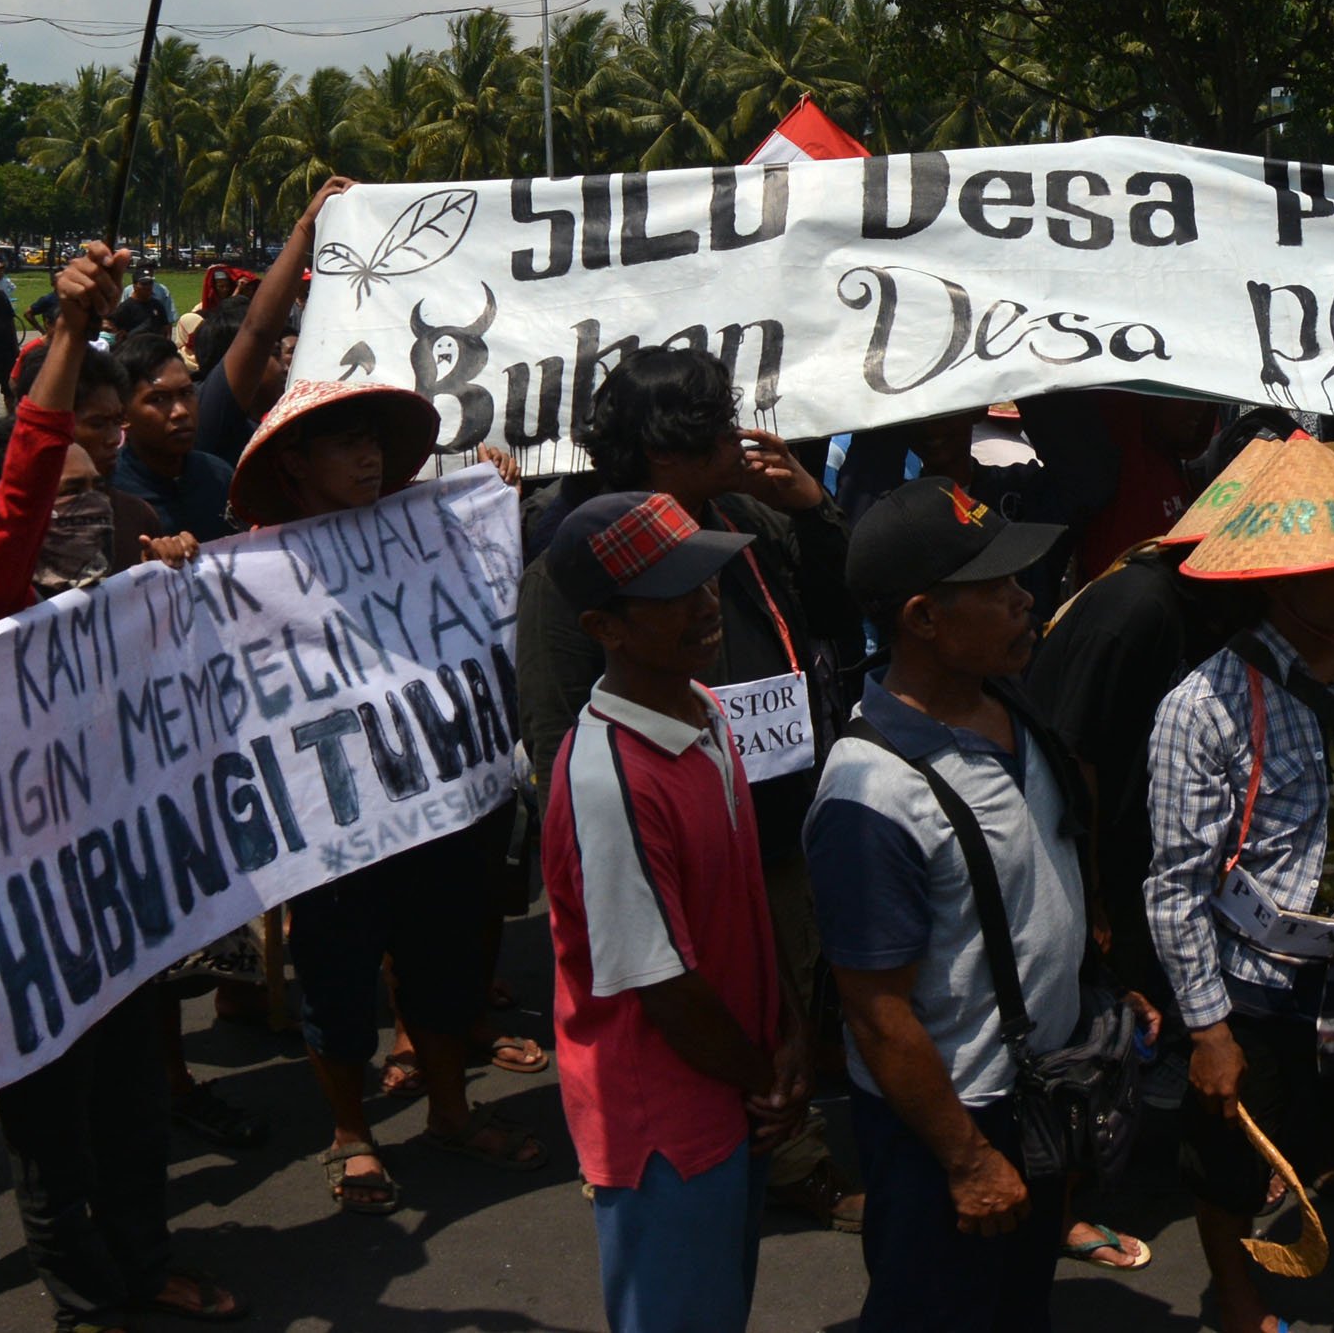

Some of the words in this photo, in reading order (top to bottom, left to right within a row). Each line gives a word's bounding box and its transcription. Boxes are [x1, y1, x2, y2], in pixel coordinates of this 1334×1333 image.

[860, 150, 1199, 250] Desa
[837, 265, 1172, 395] Desa
[16, 590, 119, 728] KAMI
[134, 542, 264, 650] TIDAK
